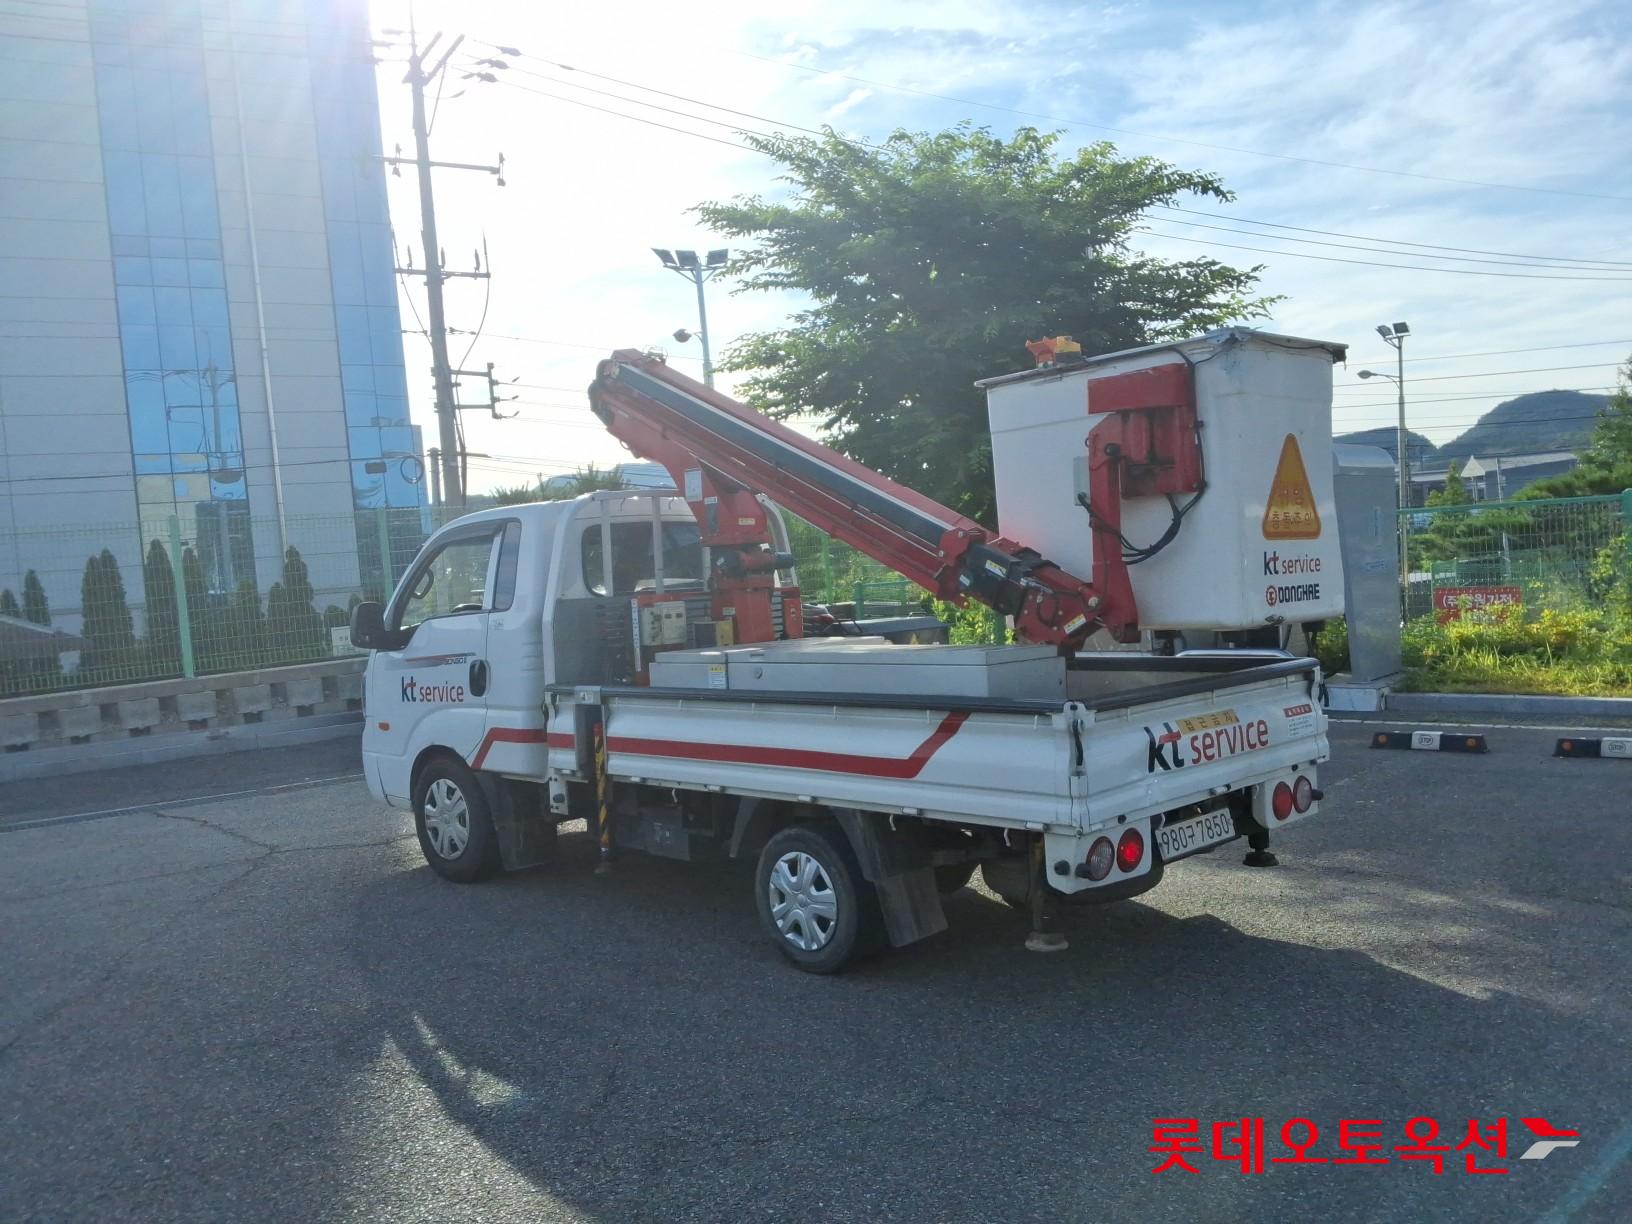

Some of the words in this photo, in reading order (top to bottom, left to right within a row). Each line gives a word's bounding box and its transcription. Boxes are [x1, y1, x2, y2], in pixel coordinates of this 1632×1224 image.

[1264, 551, 1280, 576] kt
[1282, 554, 1321, 575] service
[1277, 583, 1321, 604] DONGHAE
[401, 676, 416, 703] kt
[419, 681, 464, 703] service
[1144, 722, 1185, 773] kt
[1190, 719, 1269, 765] service
